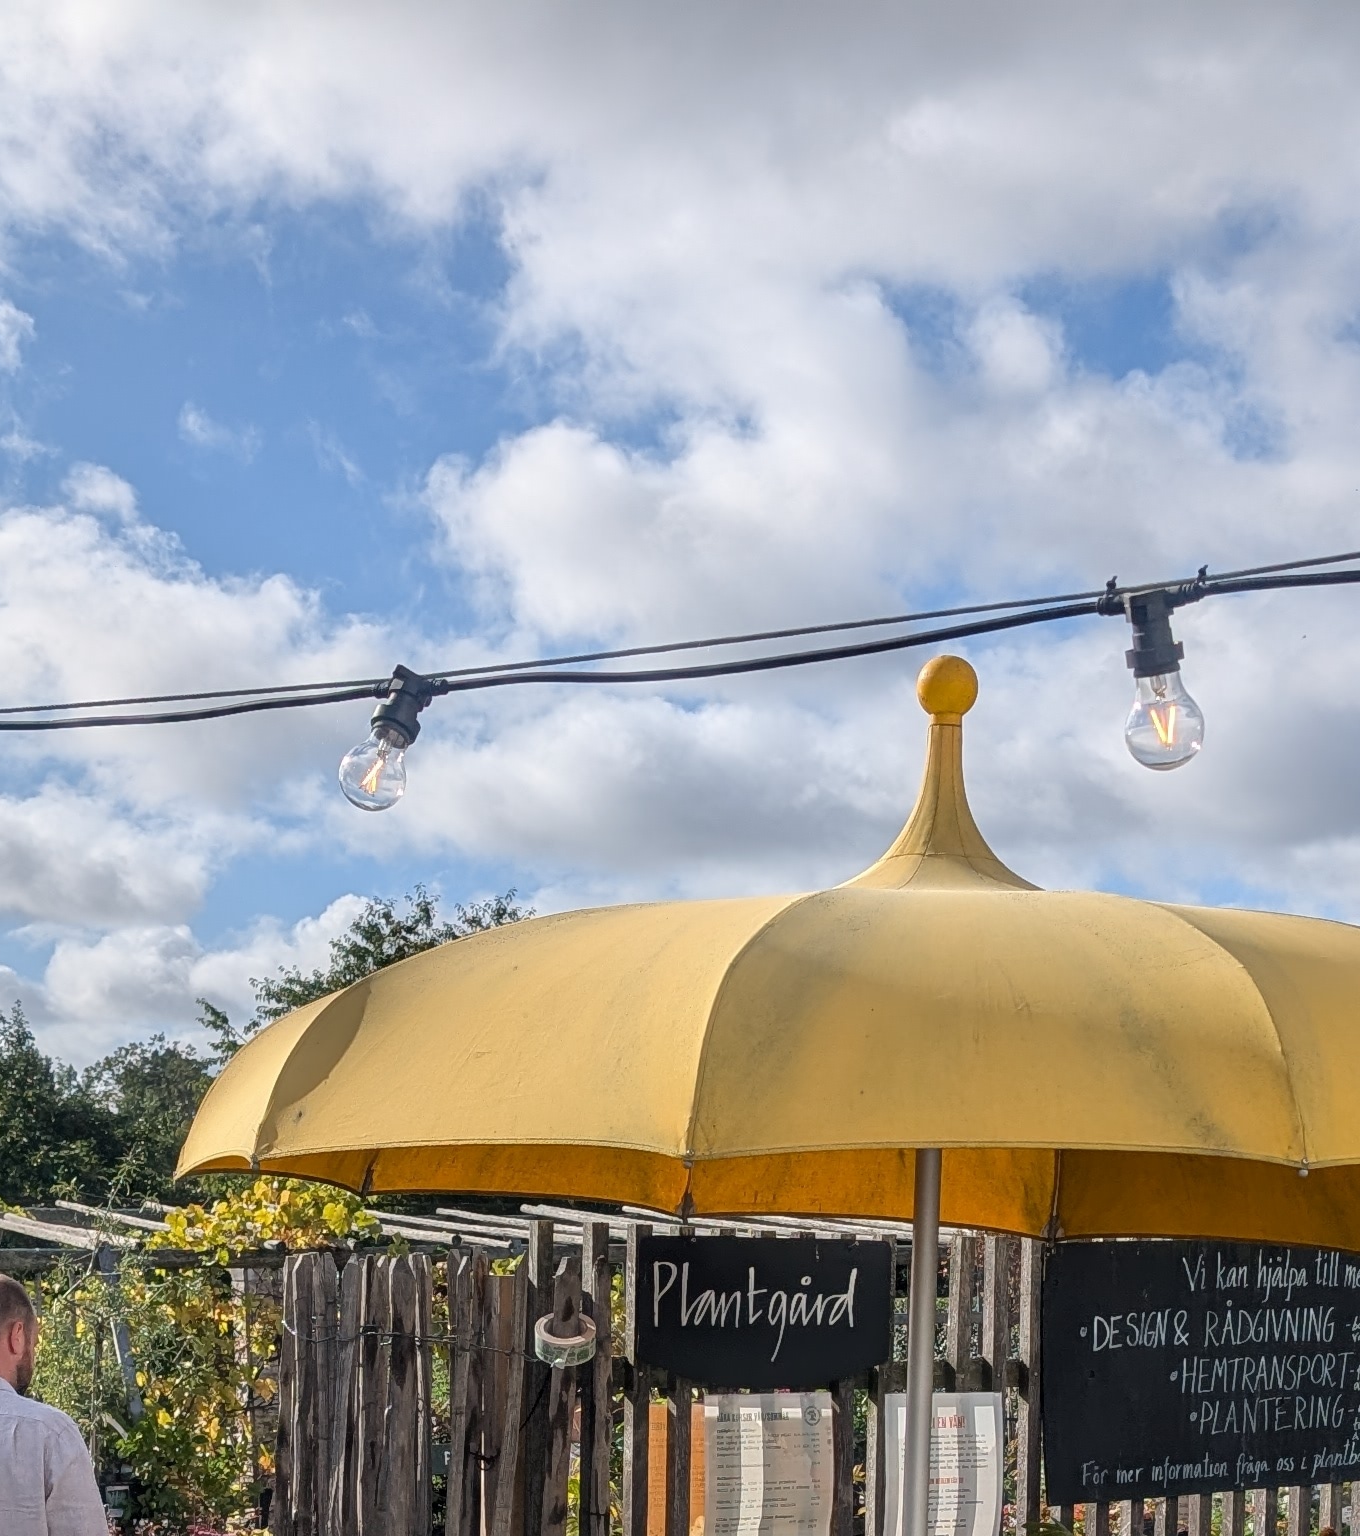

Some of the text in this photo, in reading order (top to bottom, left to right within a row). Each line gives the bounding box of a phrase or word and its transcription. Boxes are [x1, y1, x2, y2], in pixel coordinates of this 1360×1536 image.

[1182, 1254, 1206, 1291] Vi
[1216, 1251, 1248, 1290] kan
[1257, 1249, 1308, 1303] hjälpa
[1315, 1250, 1340, 1287] till
[652, 1261, 858, 1362] Plantgård
[1092, 1300, 1335, 1351] DESIGN & RÅDGIVNING
[1181, 1352, 1354, 1394] HEMTRANSPORT
[1199, 1394, 1344, 1435] PLANTERING
[1081, 1460, 1109, 1486] För
[1116, 1466, 1143, 1484] mer
[1151, 1451, 1229, 1488] information
[1235, 1453, 1269, 1485] fråga
[1276, 1457, 1295, 1472] oss
